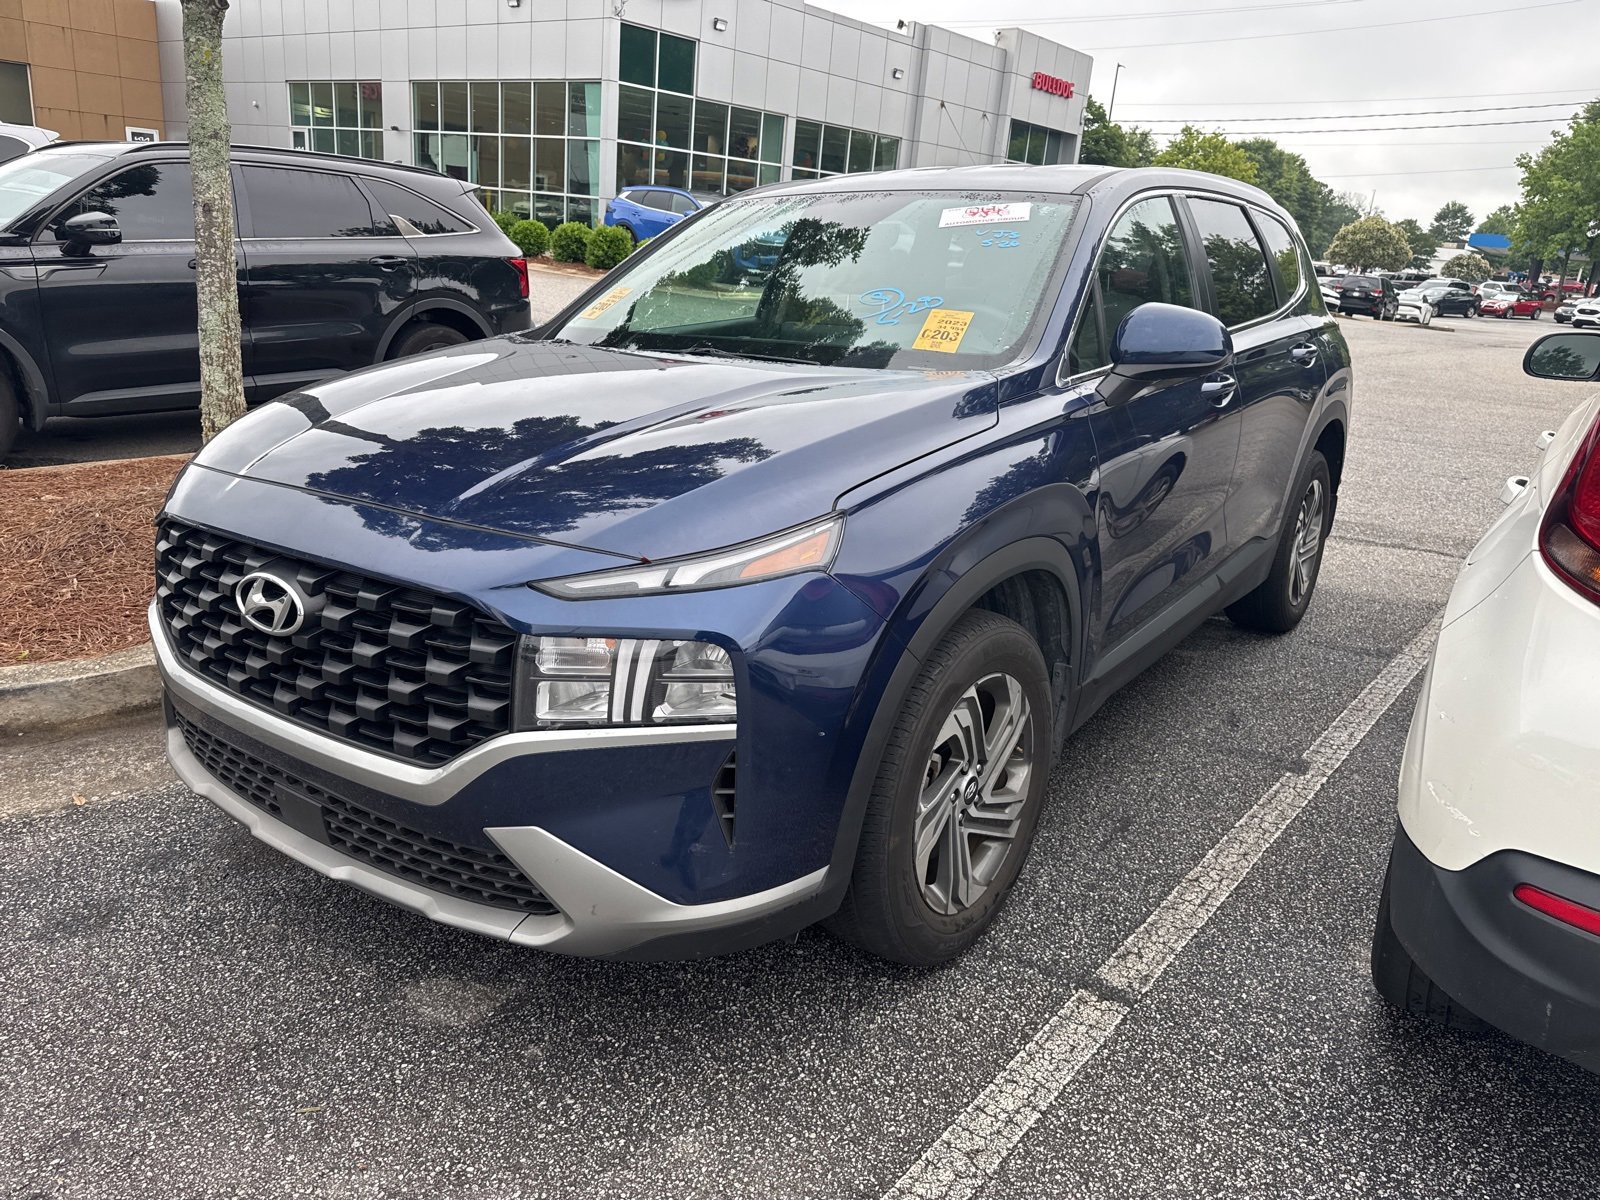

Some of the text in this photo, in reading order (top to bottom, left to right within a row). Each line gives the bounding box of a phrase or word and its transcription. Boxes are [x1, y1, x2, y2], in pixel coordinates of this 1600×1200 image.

[1032, 71, 1074, 99] BULLDOG
[945, 218, 995, 226] AUTOMOTIVE
[921, 329, 960, 341] C203
